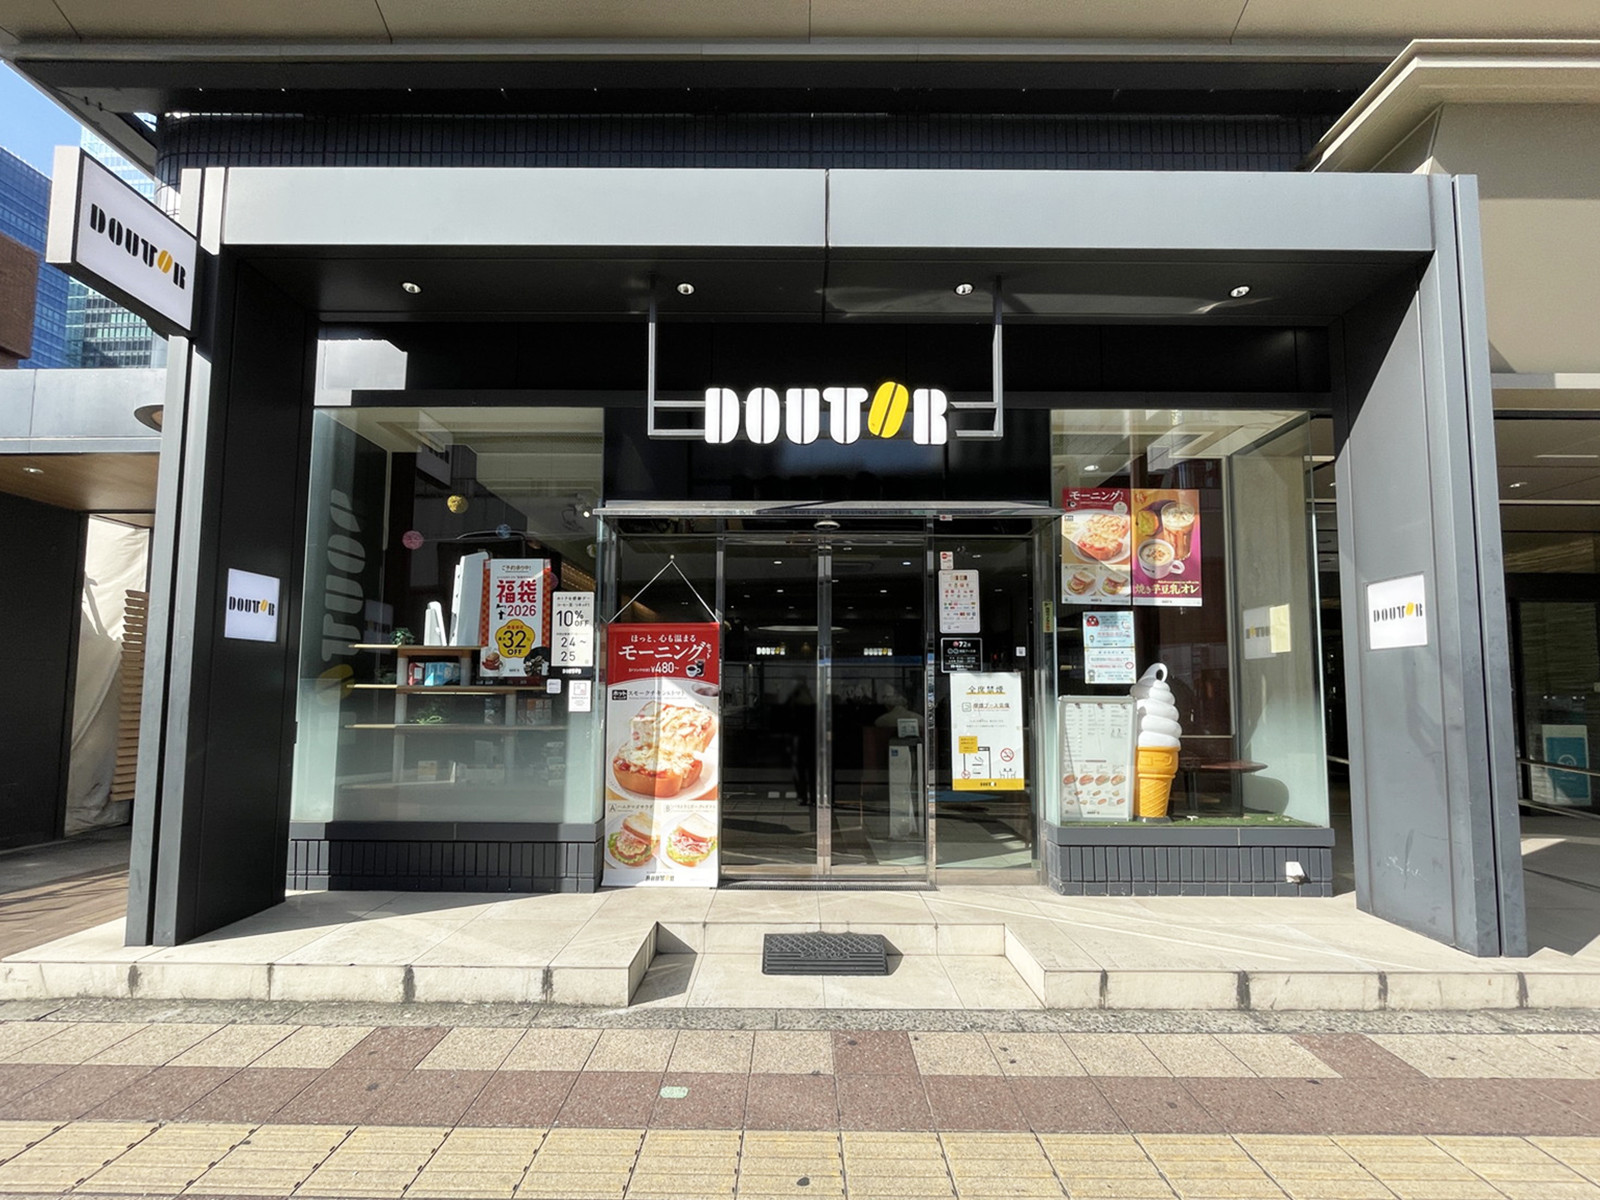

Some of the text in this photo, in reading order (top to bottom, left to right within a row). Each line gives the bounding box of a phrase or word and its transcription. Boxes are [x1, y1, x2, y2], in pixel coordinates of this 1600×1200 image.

[90, 203, 186, 290] DOUTOR
[705, 381, 947, 445] DOUTOR
[1069, 490, 1120, 502] モーニング
[496, 580, 537, 603] 福袋
[228, 596, 276, 617] DOUTOR
[507, 605, 537, 617] 2026
[1373, 602, 1423, 623] DOUTOR
[560, 651, 576, 662] 25
[618, 641, 706, 662] モーニング
